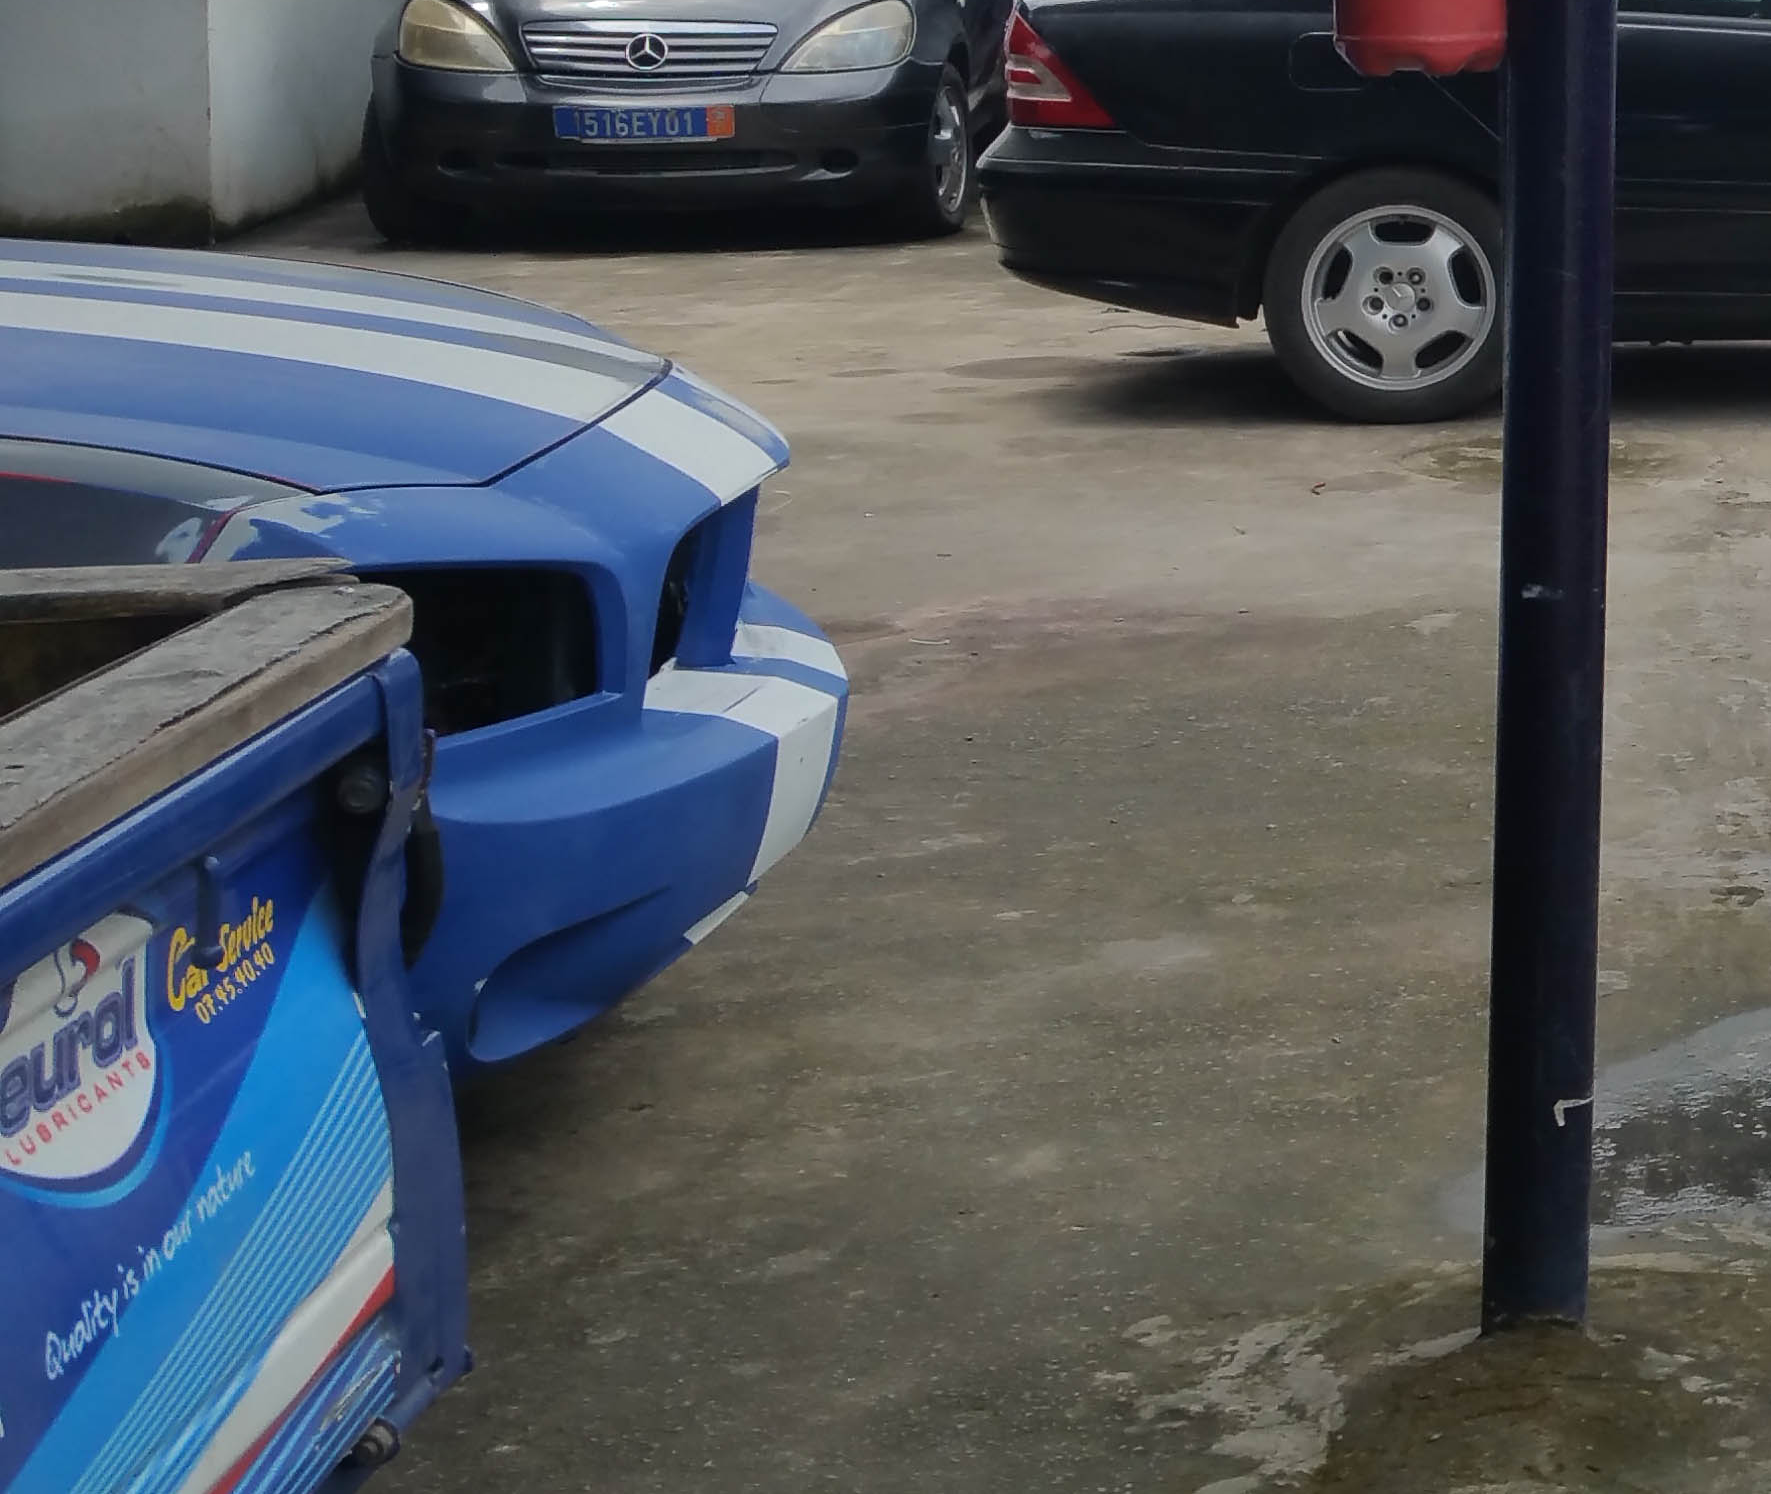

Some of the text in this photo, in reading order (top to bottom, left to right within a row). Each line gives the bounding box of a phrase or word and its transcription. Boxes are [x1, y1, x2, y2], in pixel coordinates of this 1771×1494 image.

[5, 1050, 152, 1166] LUBRICANTS
[45, 1151, 256, 1381] Quality is in our nature
